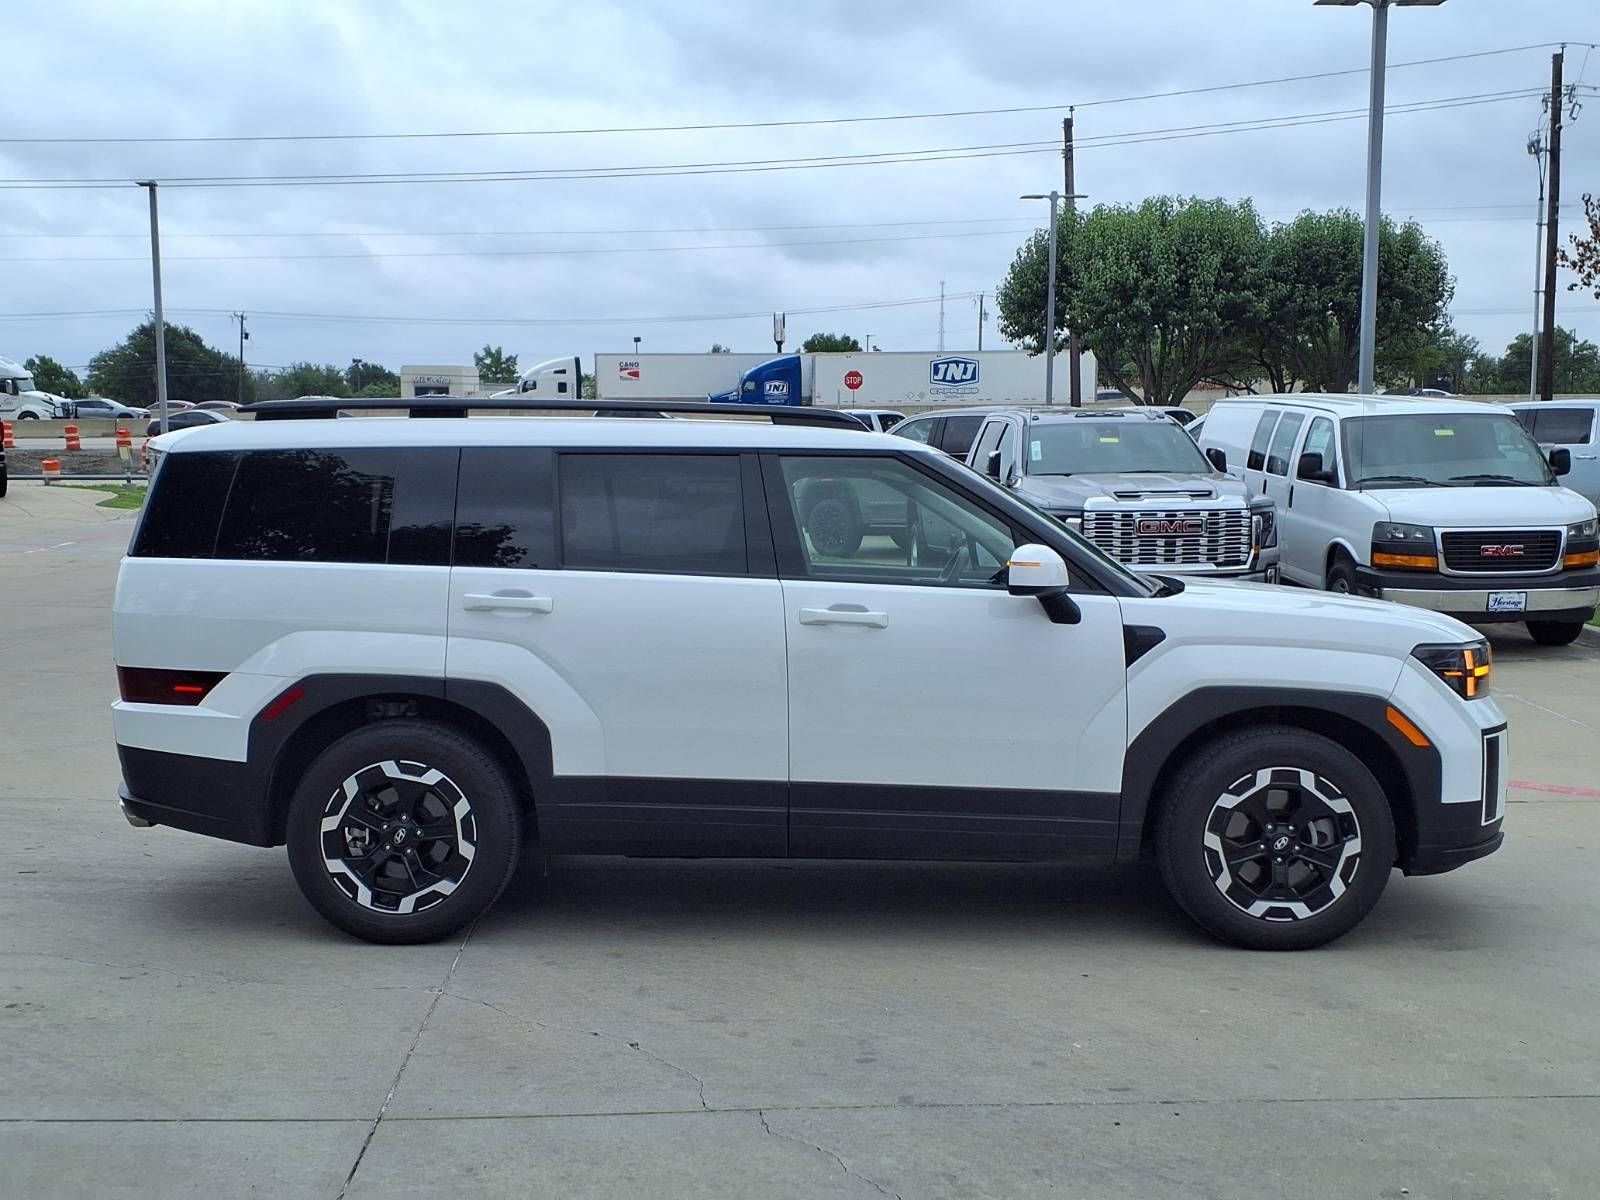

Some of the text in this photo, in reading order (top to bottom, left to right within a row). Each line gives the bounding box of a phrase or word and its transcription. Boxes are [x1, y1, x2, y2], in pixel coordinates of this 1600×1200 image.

[934, 363, 976, 380] JNJ
[845, 376, 861, 384] STOP
[767, 384, 786, 392] JNJ
[1140, 520, 1202, 533] GMC
[1480, 544, 1524, 556] GMC
